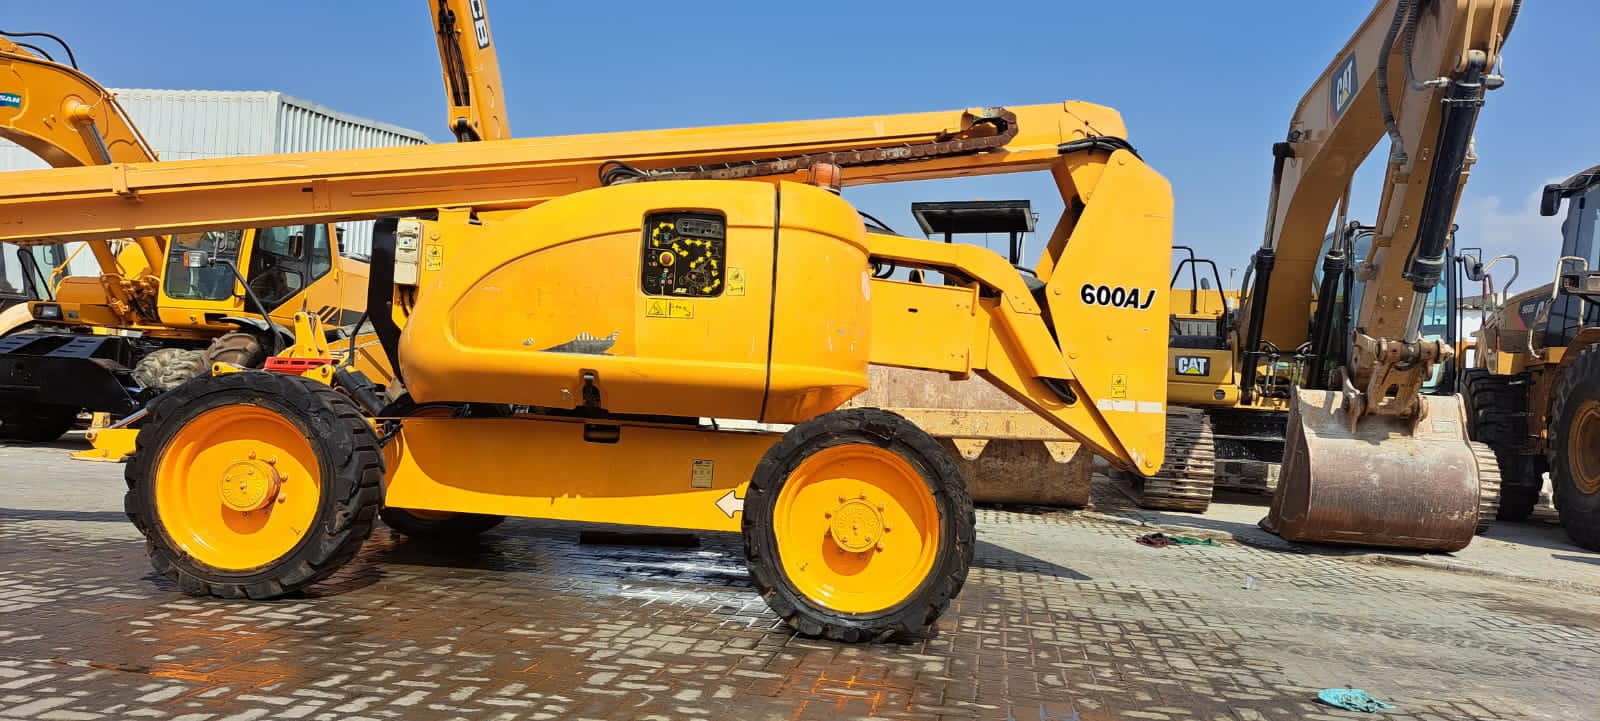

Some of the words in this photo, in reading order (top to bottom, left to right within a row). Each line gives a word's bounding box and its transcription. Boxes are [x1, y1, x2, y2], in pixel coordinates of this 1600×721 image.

[1336, 60, 1353, 112] CAT
[1080, 283, 1156, 310] 600AJ
[1178, 357, 1207, 375] CAT
